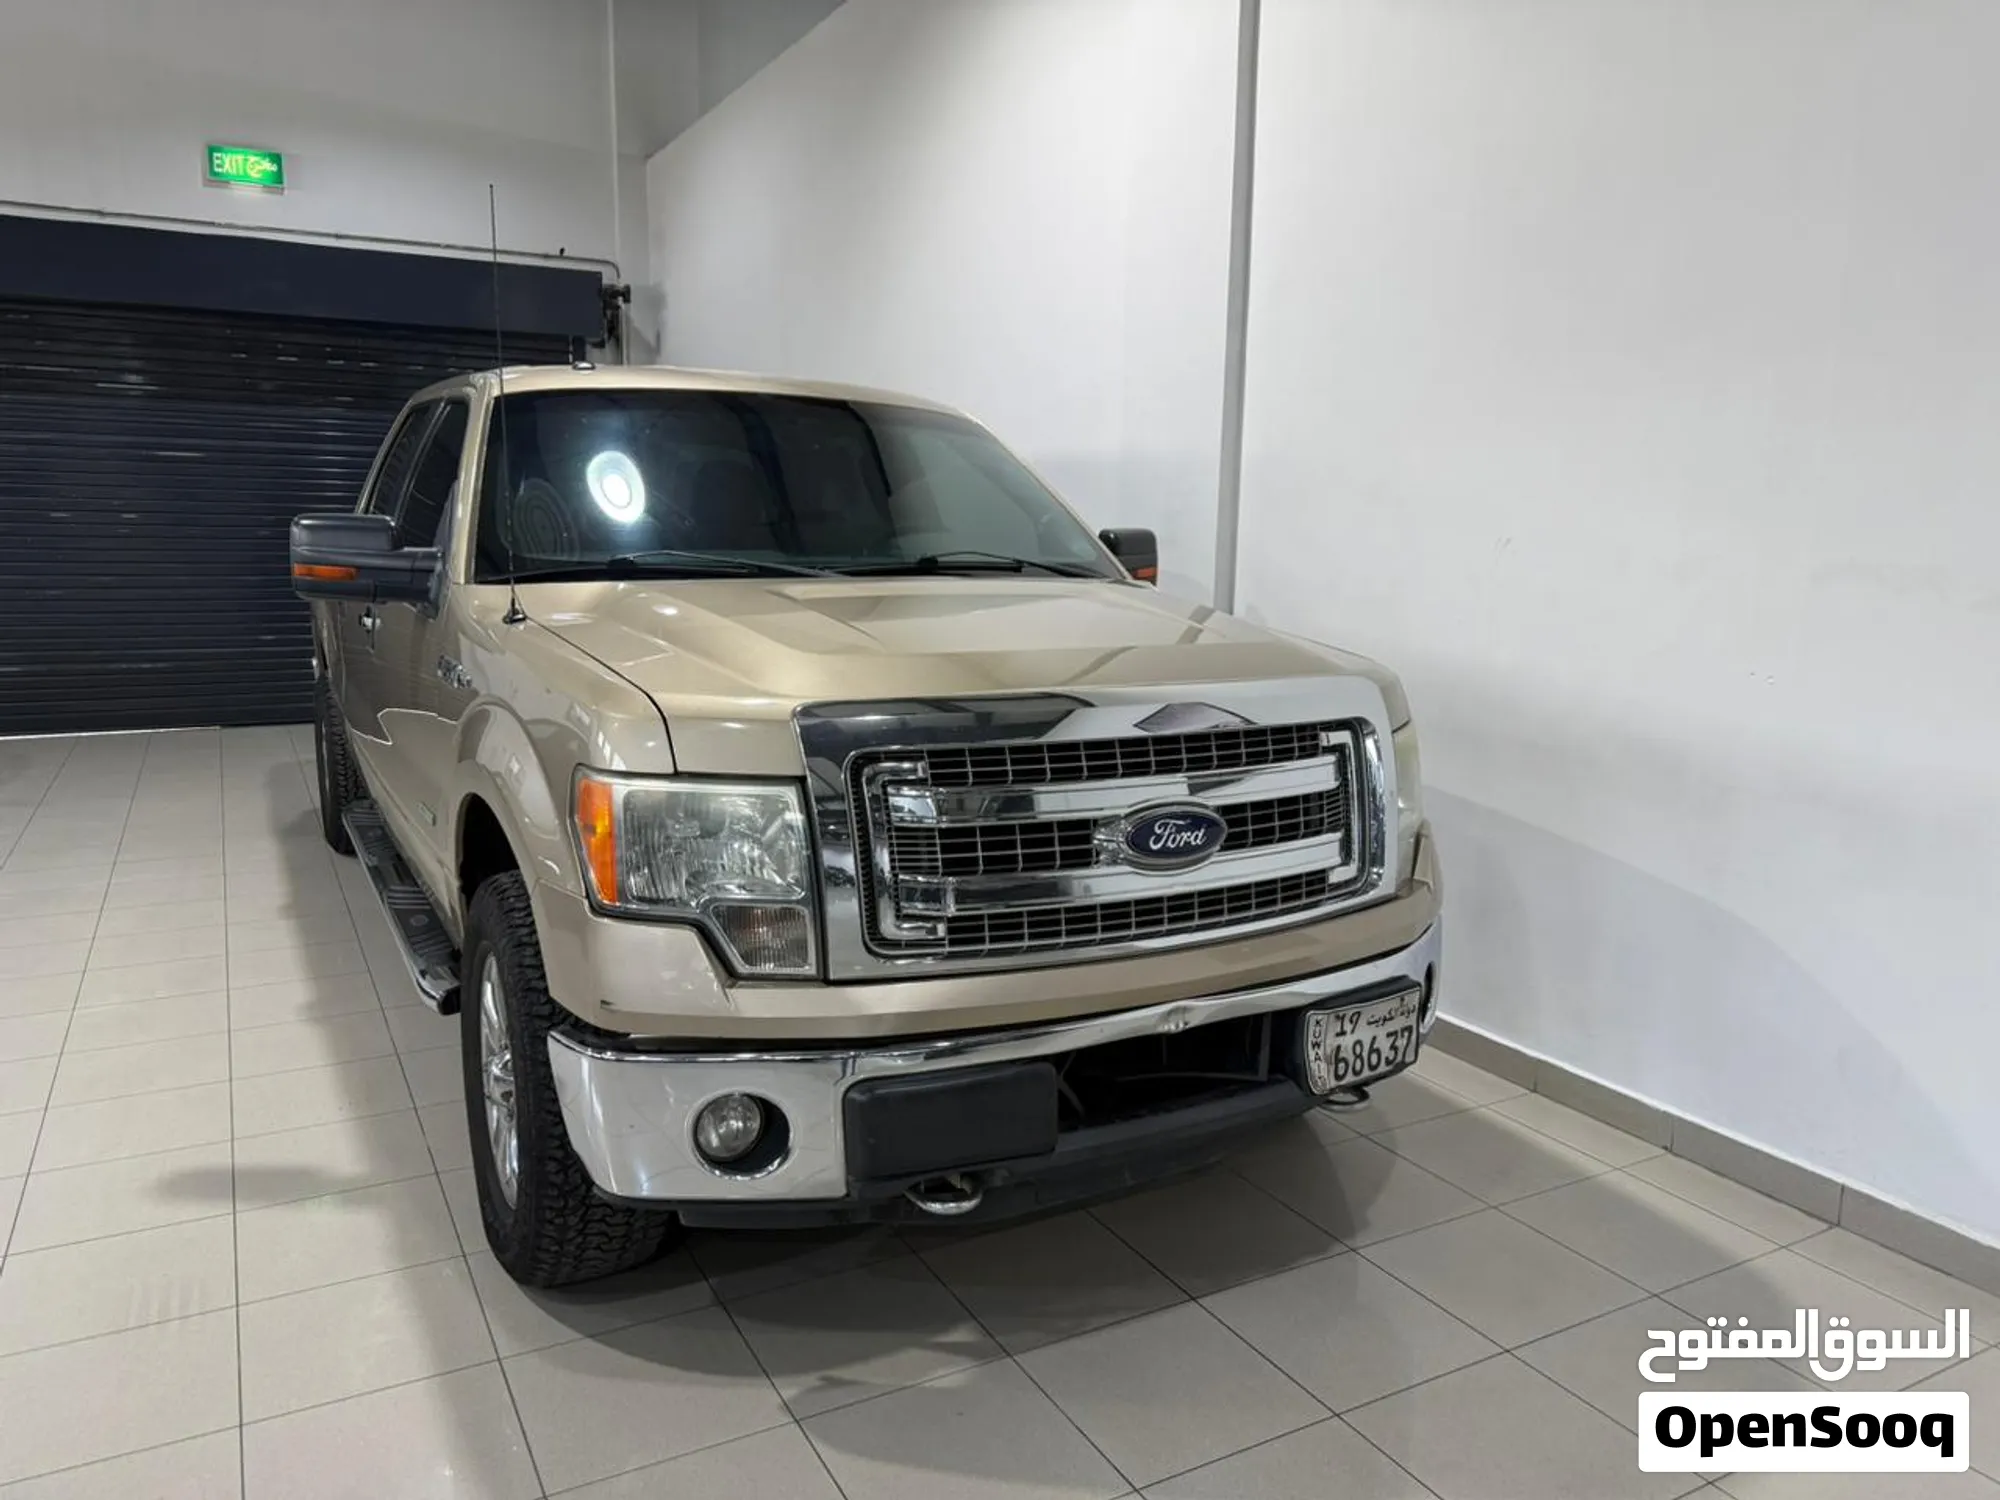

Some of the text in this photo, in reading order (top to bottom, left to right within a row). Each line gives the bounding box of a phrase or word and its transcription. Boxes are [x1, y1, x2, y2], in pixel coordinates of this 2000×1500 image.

[212, 152, 244, 176] EXIT
[1149, 818, 1207, 850] Ford
[1334, 1011, 1361, 1037] 19
[1311, 1018, 1327, 1086] KUWAIT
[1334, 1024, 1413, 1082] 68637
